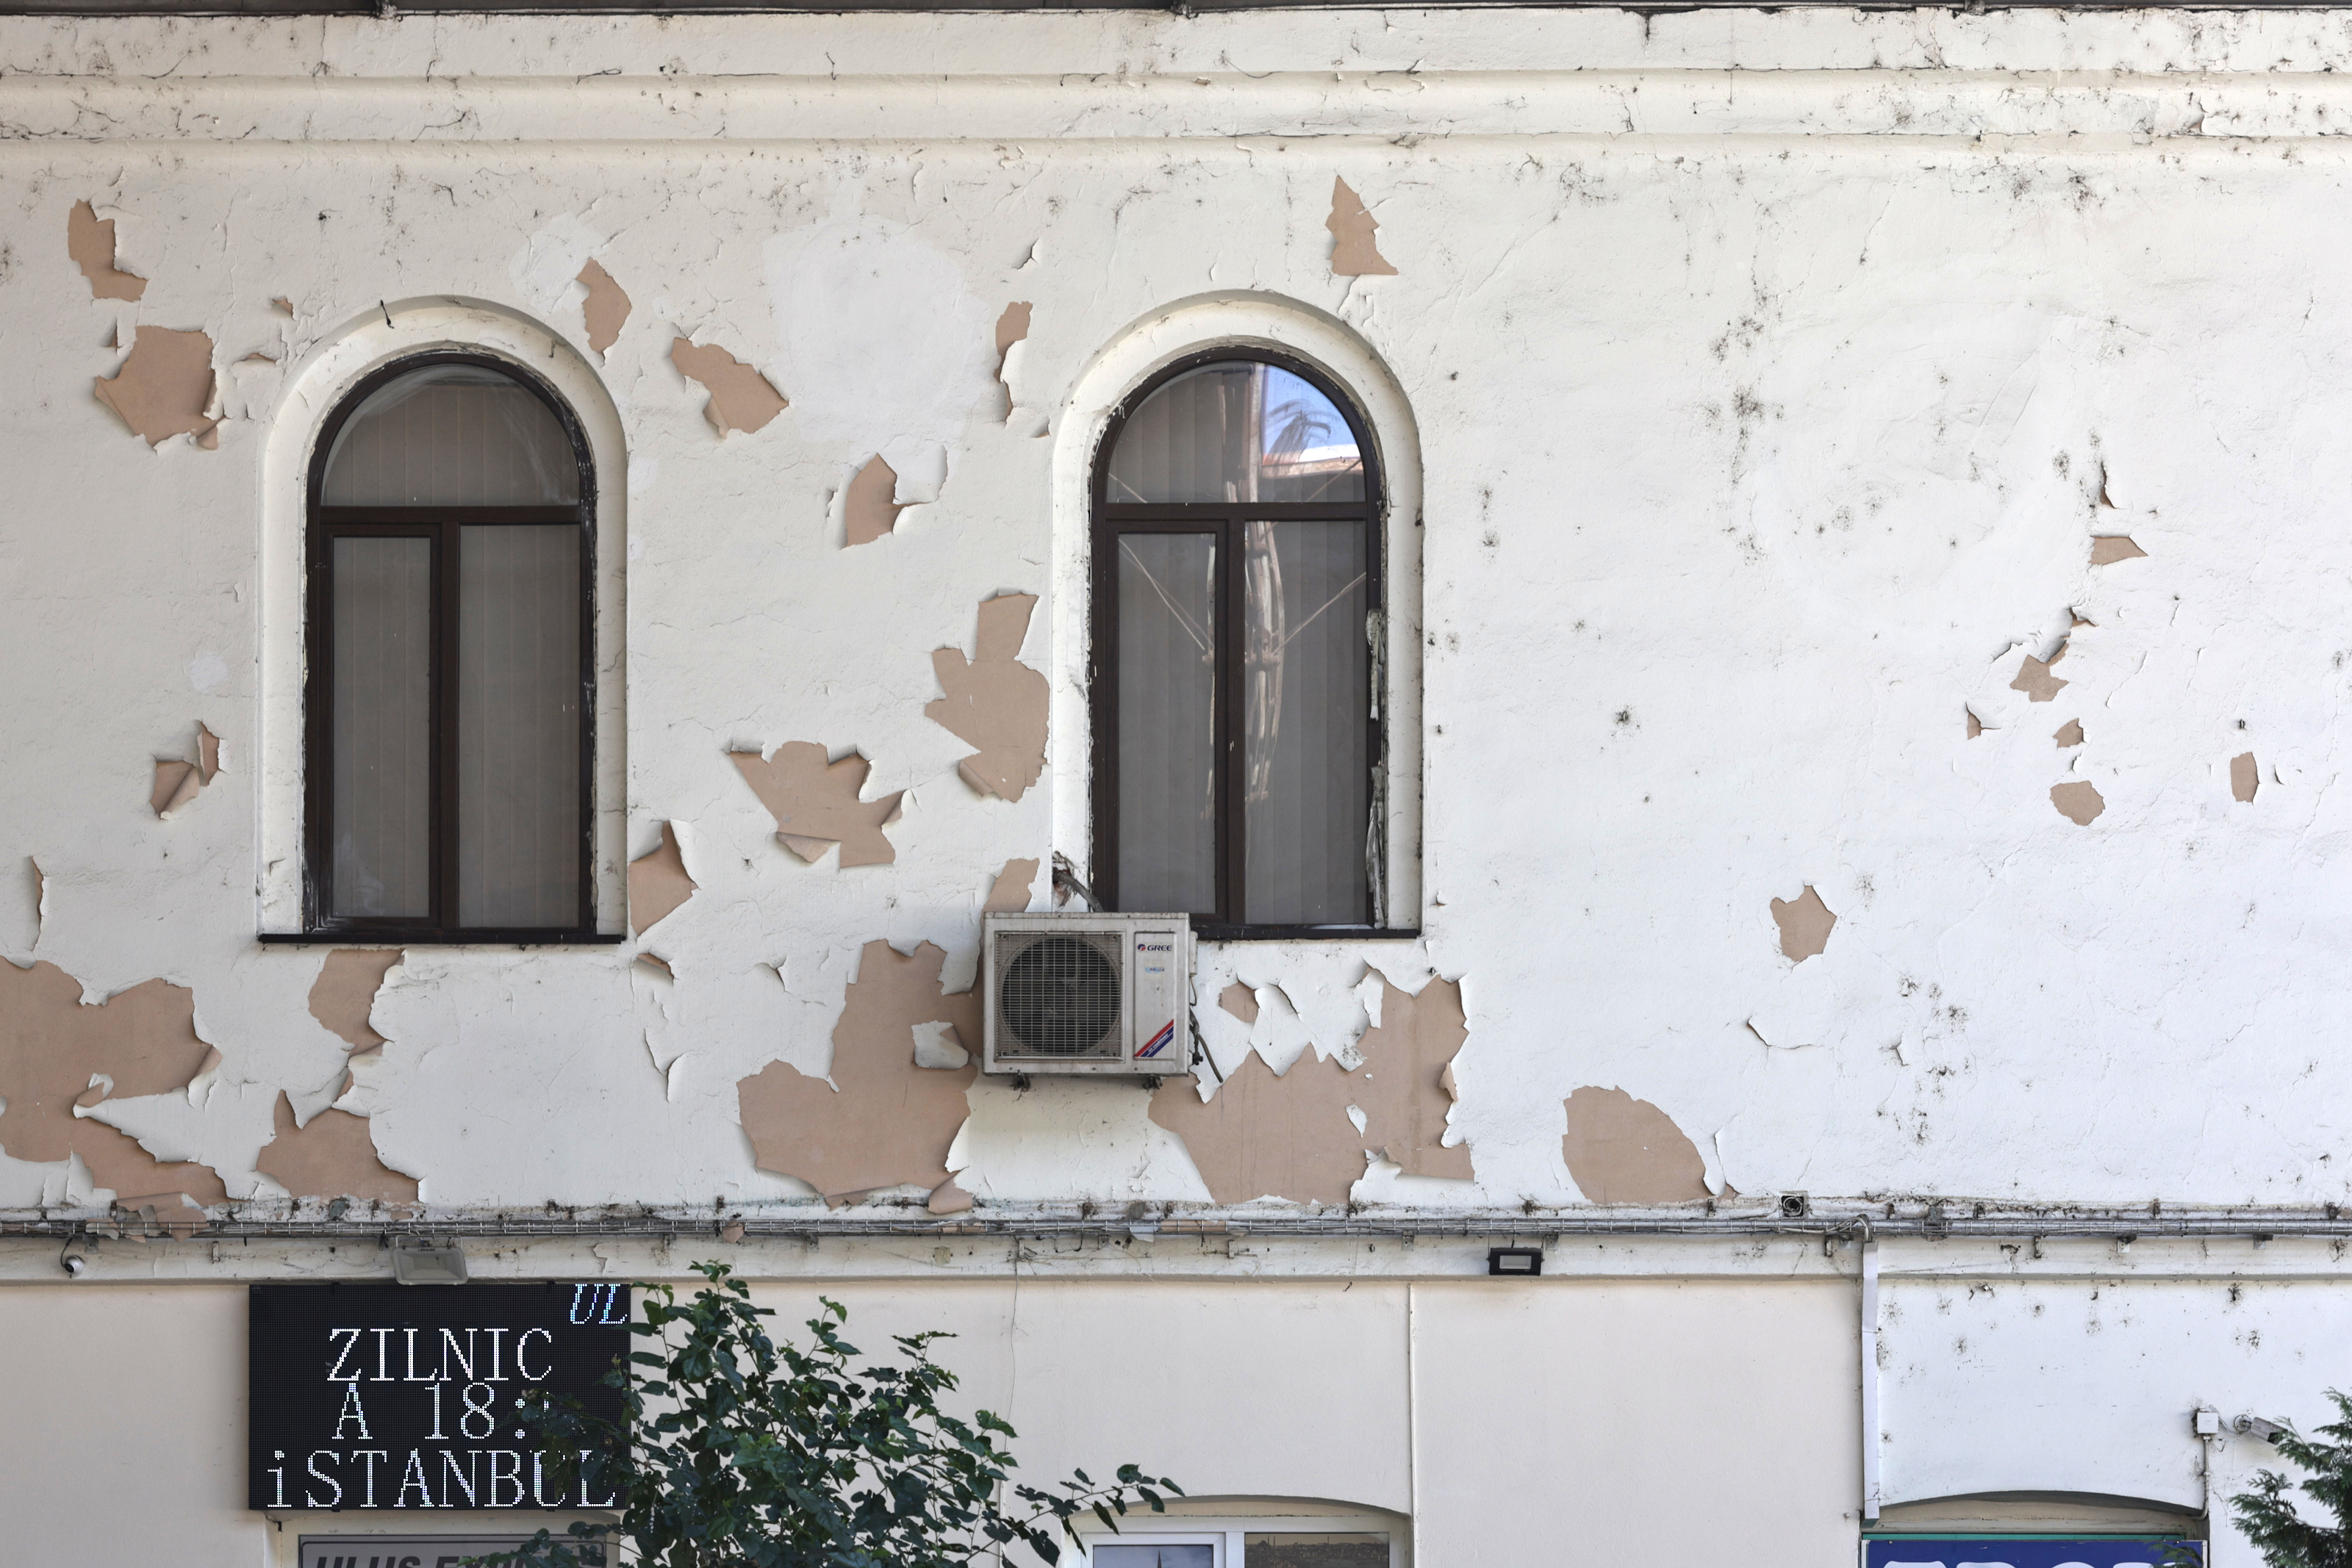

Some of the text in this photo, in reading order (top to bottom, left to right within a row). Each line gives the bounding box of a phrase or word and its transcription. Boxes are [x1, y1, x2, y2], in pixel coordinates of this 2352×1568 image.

[570, 1283, 628, 1325] UL
[327, 1328, 552, 1381] ZILNIC
[332, 1383, 373, 1439] A
